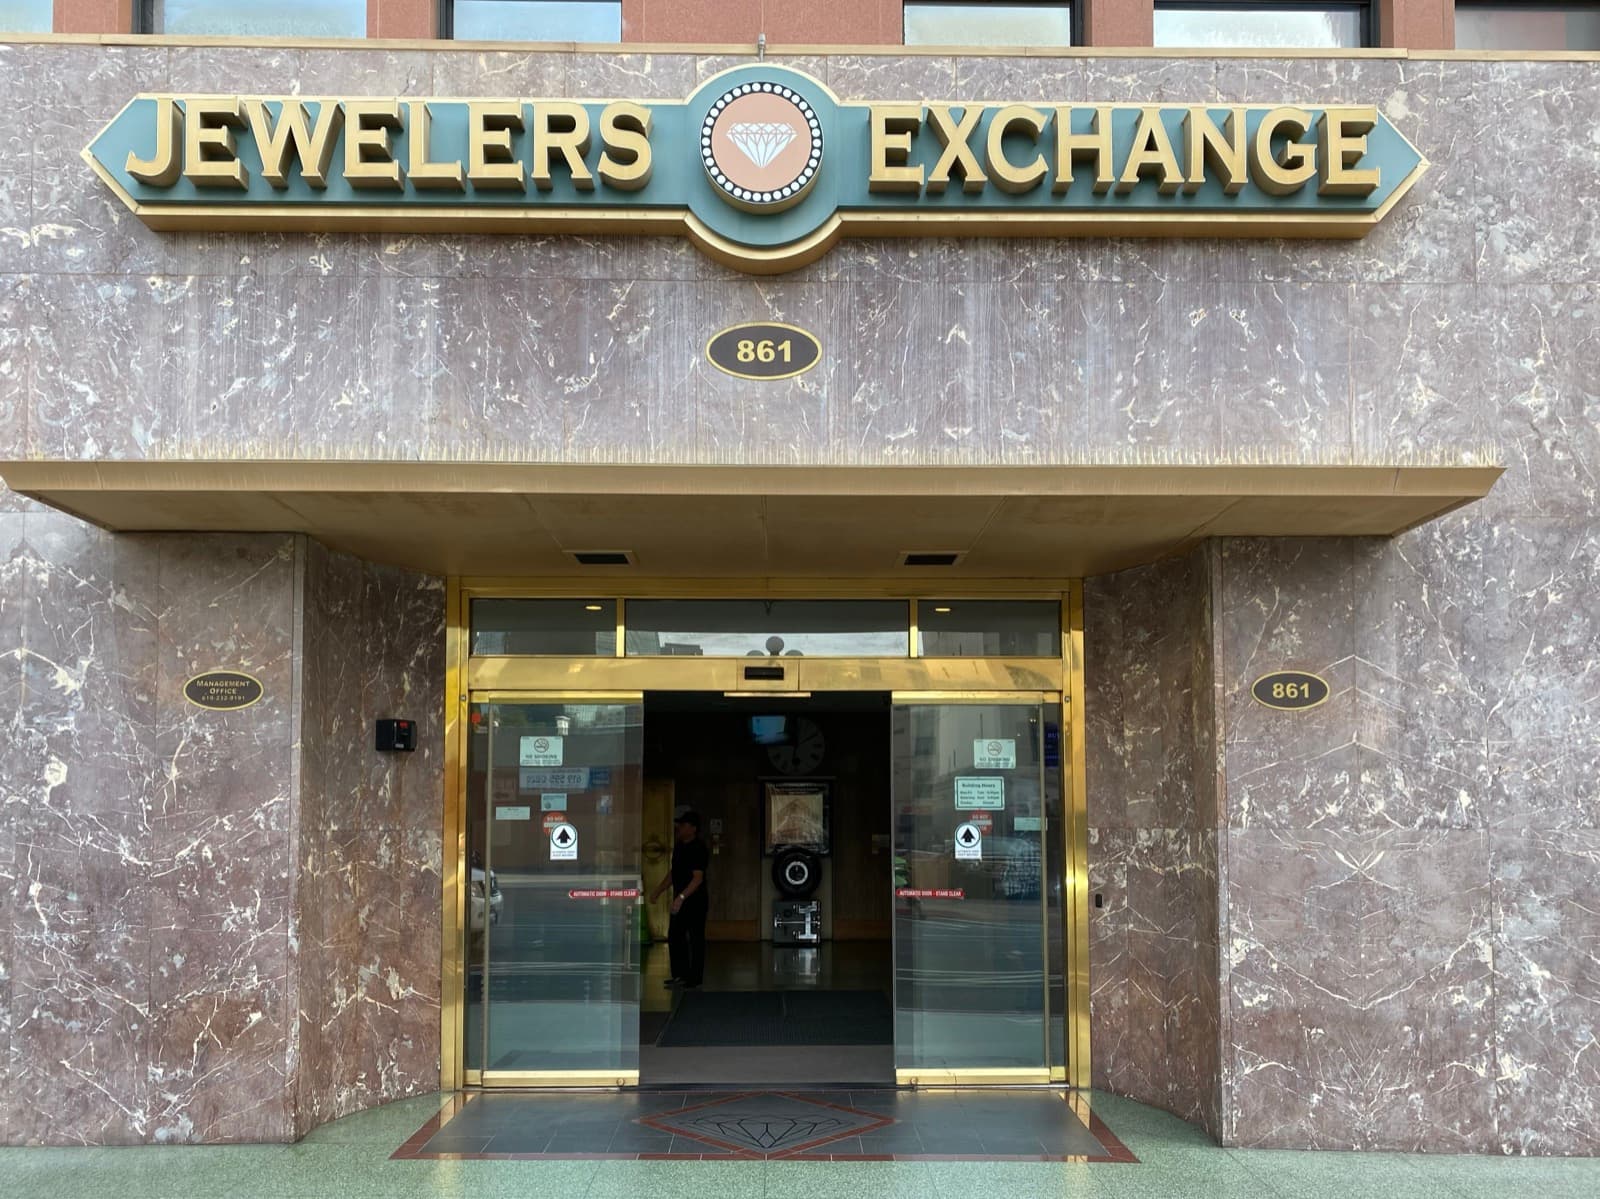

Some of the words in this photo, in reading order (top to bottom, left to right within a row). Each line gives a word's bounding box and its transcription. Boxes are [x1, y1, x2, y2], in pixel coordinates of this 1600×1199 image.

[125, 97, 654, 191] JEWELERS
[868, 104, 1382, 197] EXCHANGE
[736, 339, 792, 363] 861
[1272, 682, 1310, 699] 861
